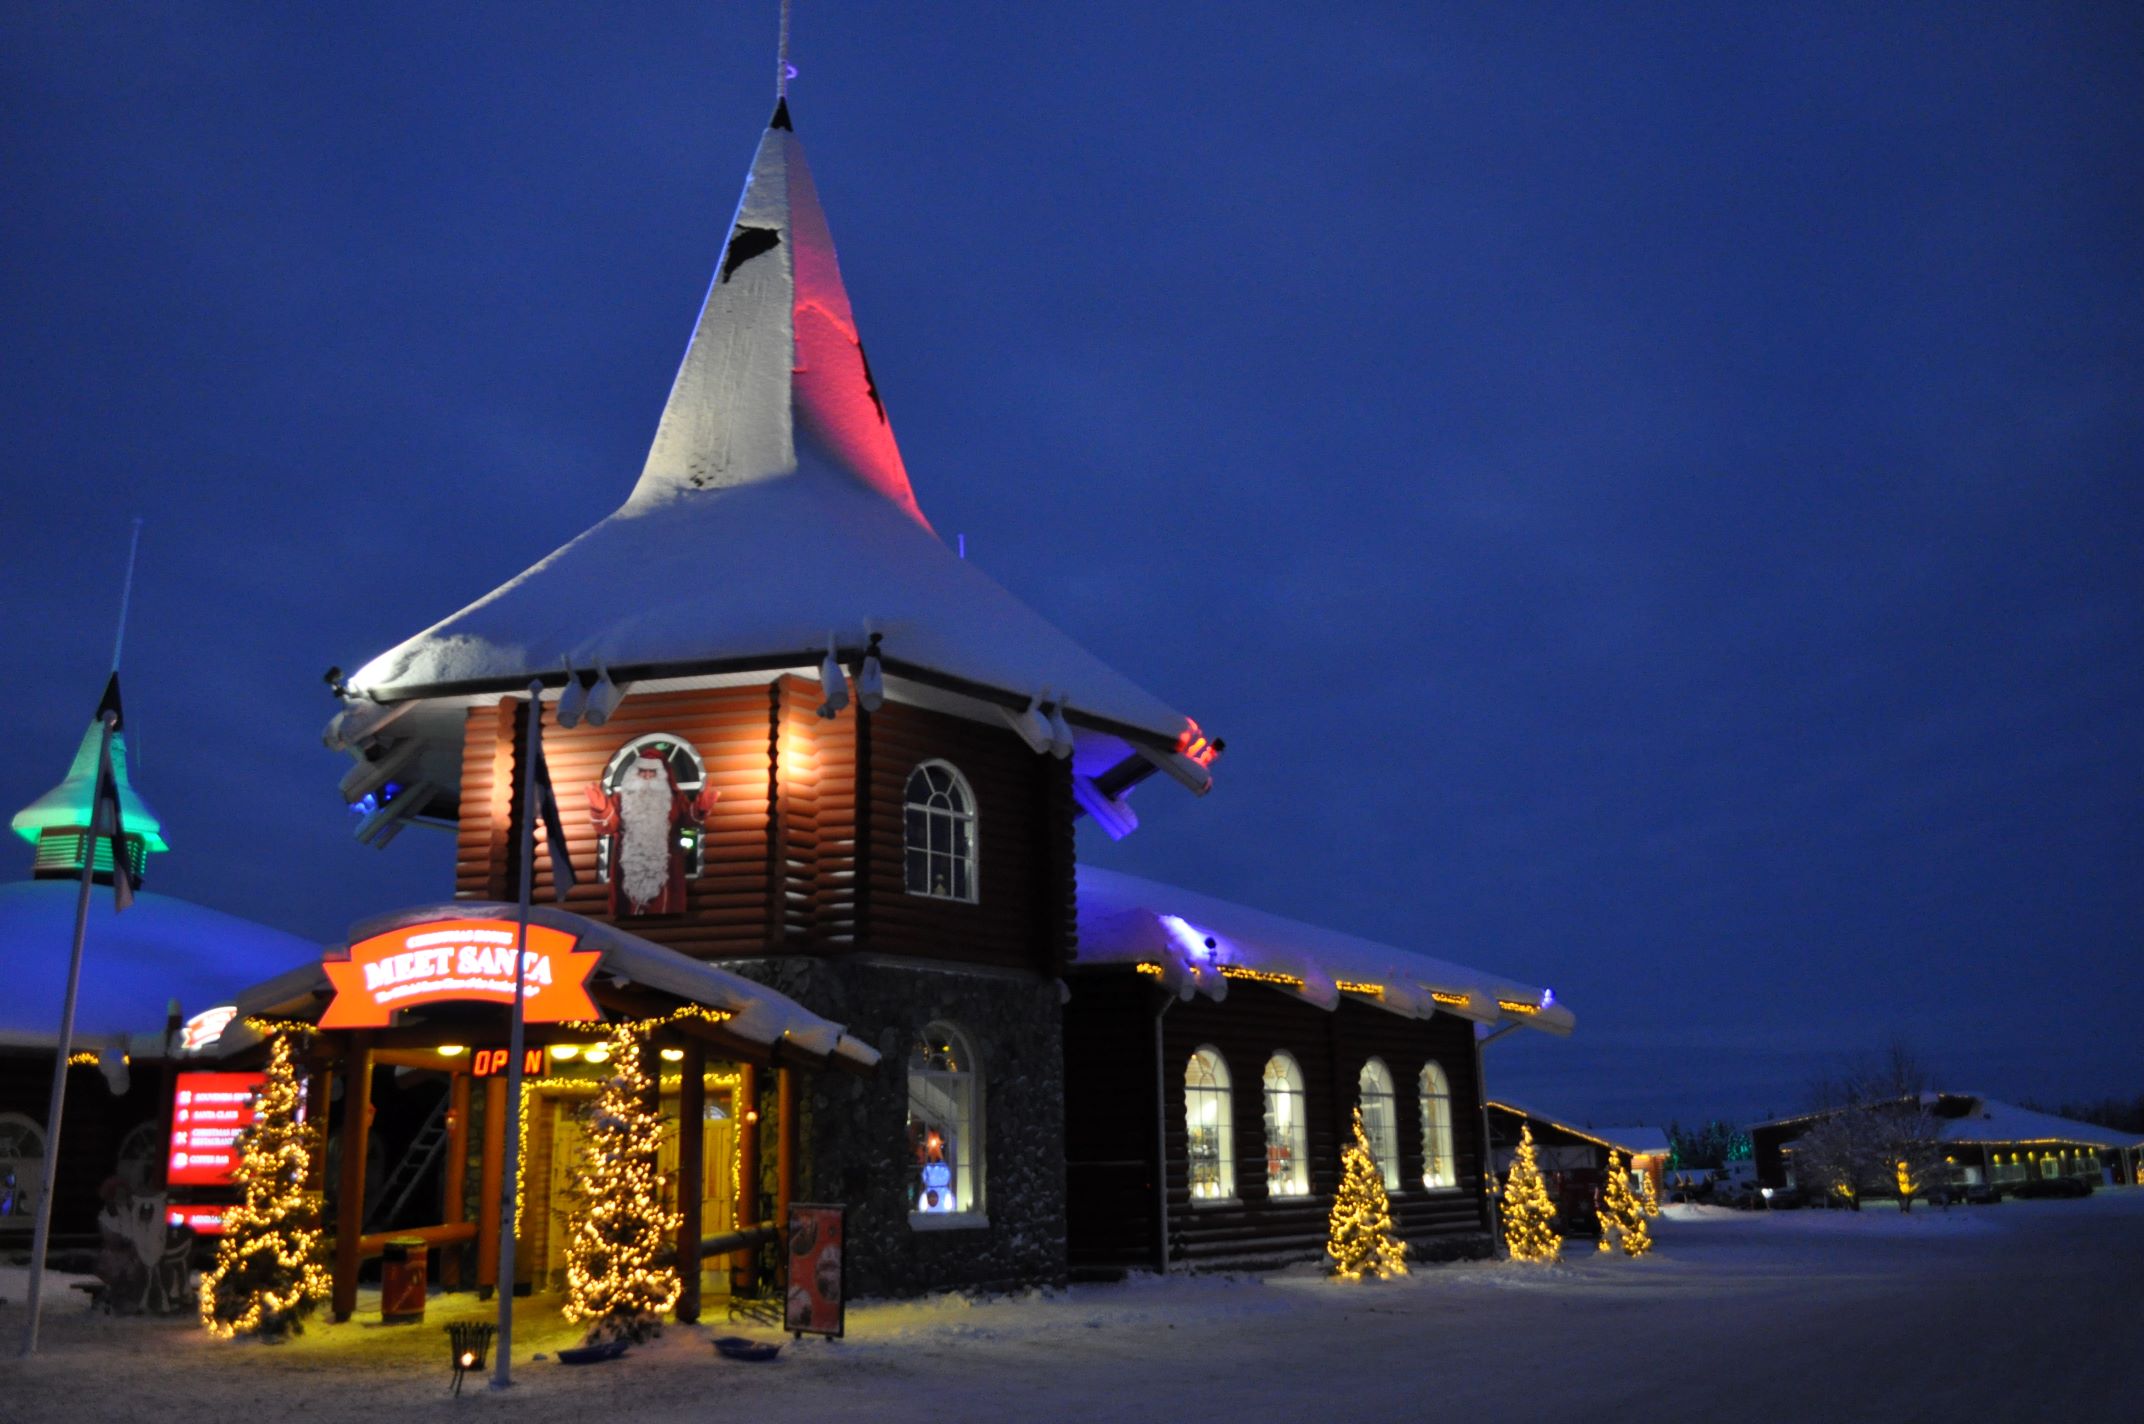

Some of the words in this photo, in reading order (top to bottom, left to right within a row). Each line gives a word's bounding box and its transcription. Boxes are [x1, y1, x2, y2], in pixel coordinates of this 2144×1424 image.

[364, 947, 454, 990] MEET
[457, 946, 552, 985] SANTA
[473, 1049, 543, 1077] OPN
